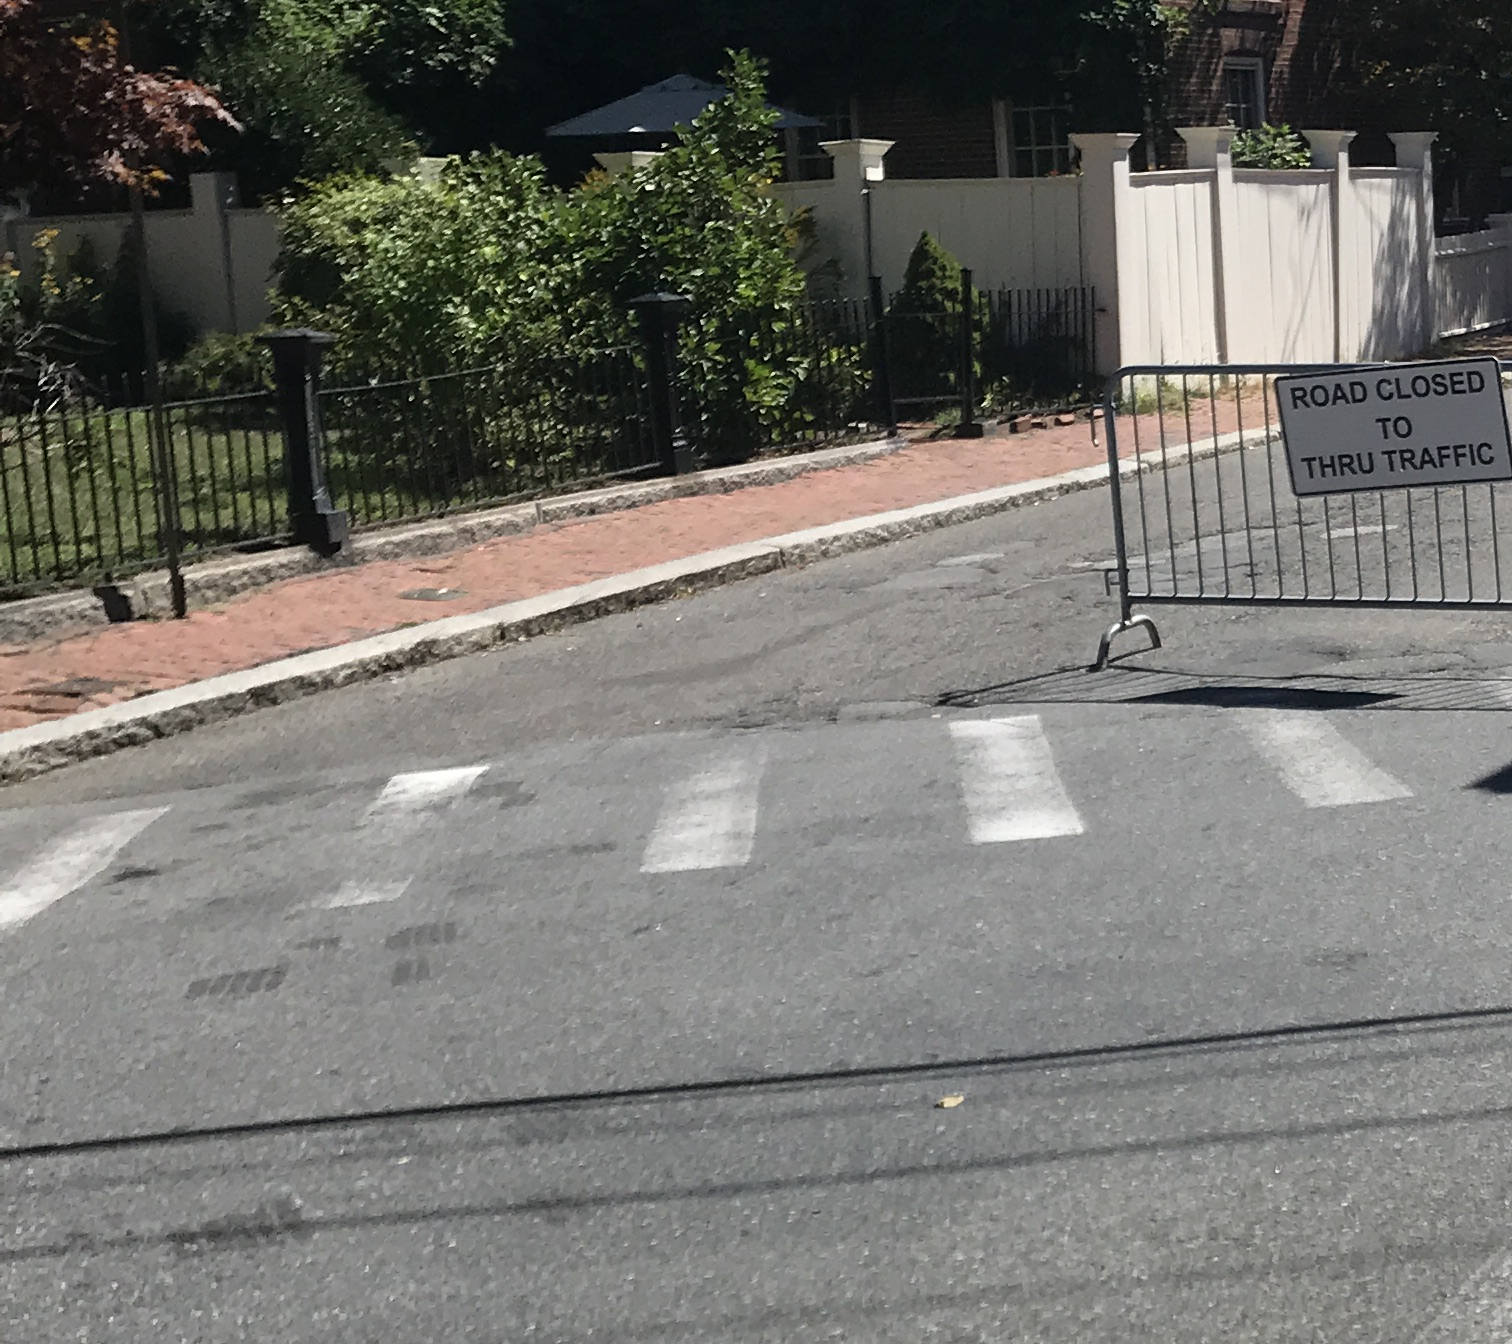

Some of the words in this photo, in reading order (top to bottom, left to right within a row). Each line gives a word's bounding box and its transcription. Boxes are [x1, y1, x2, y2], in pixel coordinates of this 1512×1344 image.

[1290, 381, 1367, 409] ROAD
[1376, 371, 1485, 401] CLOSED
[1375, 416, 1413, 439] TO
[1301, 452, 1375, 479] THRU
[1382, 442, 1495, 472] TRAFFIC
